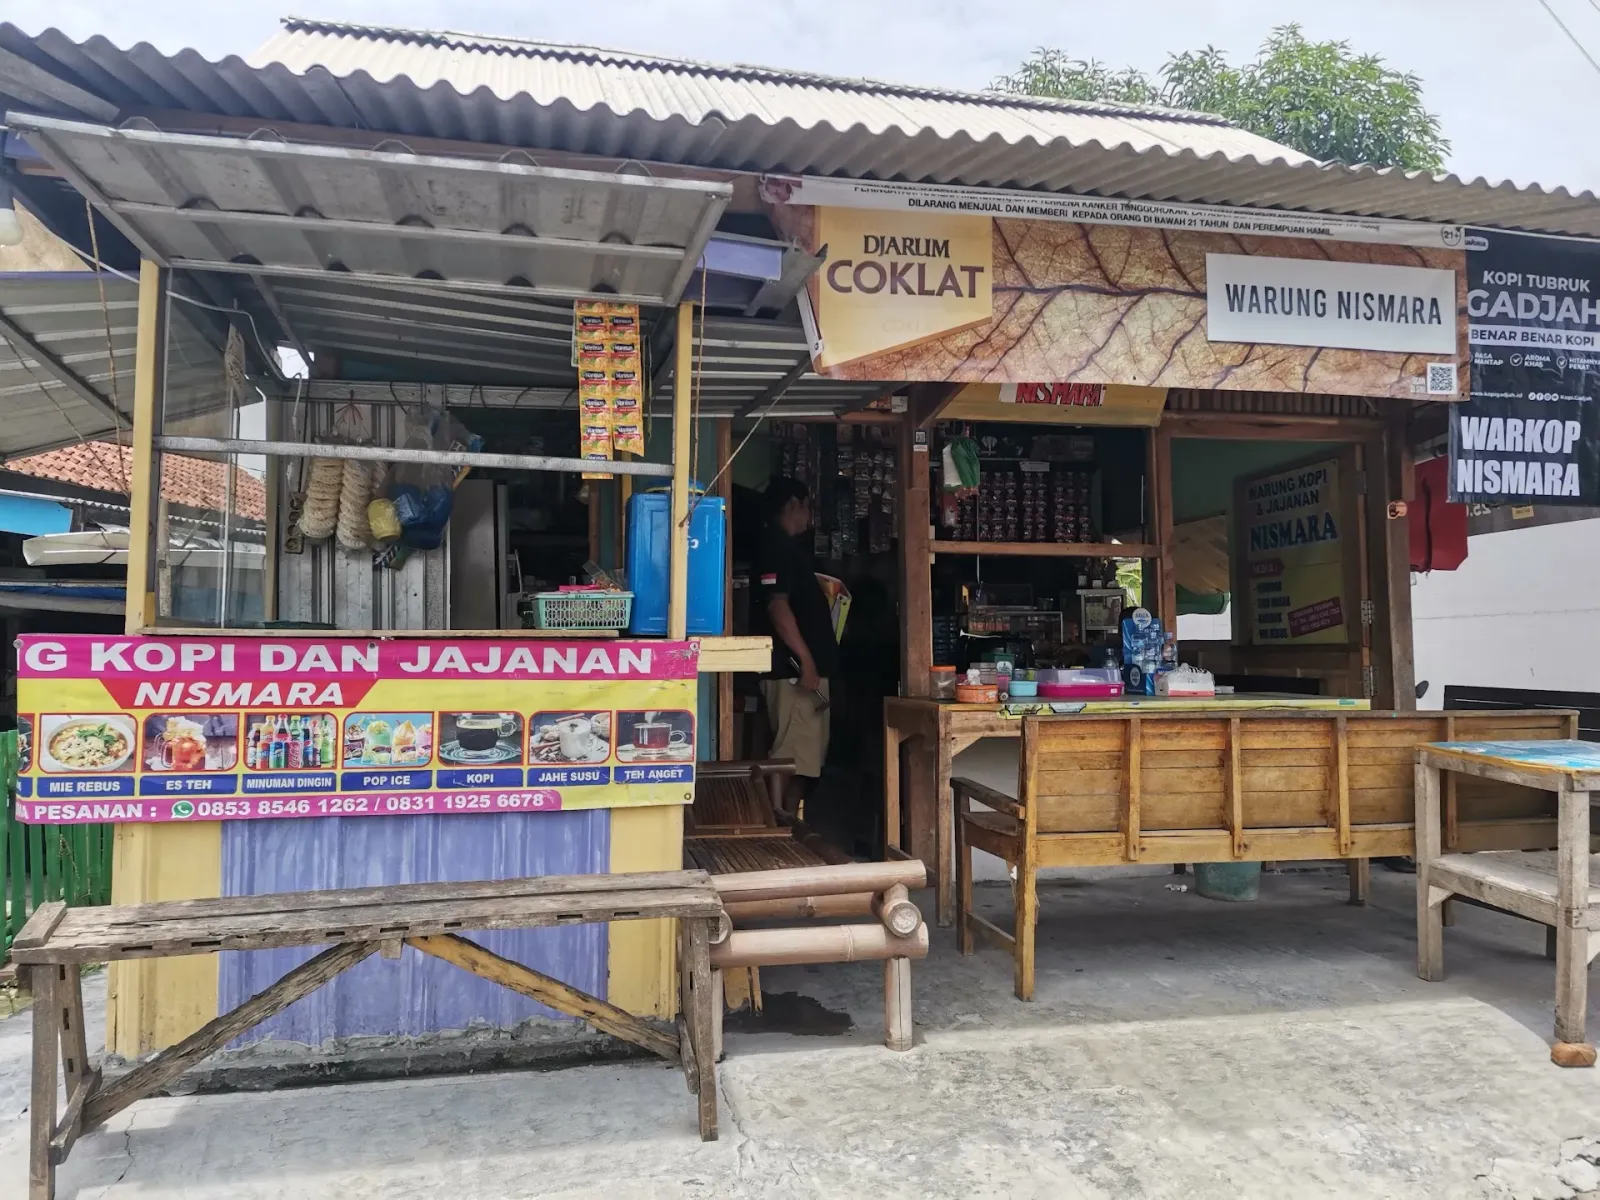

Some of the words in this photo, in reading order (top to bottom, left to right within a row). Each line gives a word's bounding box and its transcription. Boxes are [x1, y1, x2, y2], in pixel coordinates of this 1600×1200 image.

[908, 198, 956, 209] DILARANG
[959, 202, 1003, 212] MENJUAL
[1005, 205, 1024, 213] DAN
[1026, 206, 1068, 217] MEMBERI
[1072, 210, 1108, 220] KEPADA
[1110, 213, 1141, 222] ORANG
[1143, 215, 1152, 223] DI
[1154, 216, 1186, 225] BAWAH
[1188, 219, 1197, 227] 21
[1200, 219, 1229, 228] TAHUN
[1233, 222, 1251, 230] DAN
[1253, 223, 1305, 234] PEREMPUAN
[863, 234, 950, 258] DJARUM
[1444, 230, 1460, 239] 21+
[826, 259, 984, 298] COKLAT
[1483, 270, 1522, 288] KOPI
[1526, 274, 1590, 293] TUBRUK
[1225, 283, 1327, 318] WARUNG
[1337, 290, 1442, 325] NISMARA
[1467, 289, 1600, 325] GADJAH
[1471, 329, 1517, 342] BENAR
[1521, 332, 1562, 344] BENAR
[1566, 335, 1595, 347] KOPI
[1474, 358, 1504, 366] MANTAP
[1524, 354, 1551, 362] AROMA
[1460, 416, 1581, 454] WARKOP
[1248, 477, 1296, 499] WARUNG
[1299, 468, 1328, 488] KOPI
[1457, 459, 1580, 497] NISMARA
[1266, 489, 1320, 514] JAJANAN
[1250, 511, 1338, 552] NISMARA
[17, 642, 67, 672] G
[90, 643, 235, 672] KOPI
[260, 644, 379, 672] DAN
[399, 646, 651, 674] JAJANAN
[133, 682, 344, 706] NISMARA
[166, 780, 183, 791] ES
[185, 779, 212, 791] TEH
[246, 778, 295, 789] MINUMAN
[297, 777, 332, 788] DINGIN
[363, 775, 388, 786] POP
[390, 775, 411, 786] ICE
[466, 773, 494, 785] KOPI
[538, 771, 568, 783] JAHE
[570, 771, 600, 782] SUSU
[624, 769, 646, 780] TEH
[648, 768, 684, 779] ANGET
[49, 782, 73, 793] MIE
[76, 781, 121, 793] REBUS
[34, 803, 143, 819] PESANAN
[198, 801, 250, 816] 0853
[258, 800, 310, 814] 8546
[318, 799, 368, 813] 1262
[374, 797, 380, 811] /
[386, 797, 434, 811] 0831
[443, 795, 491, 809] 1925
[497, 793, 544, 807] 6678
